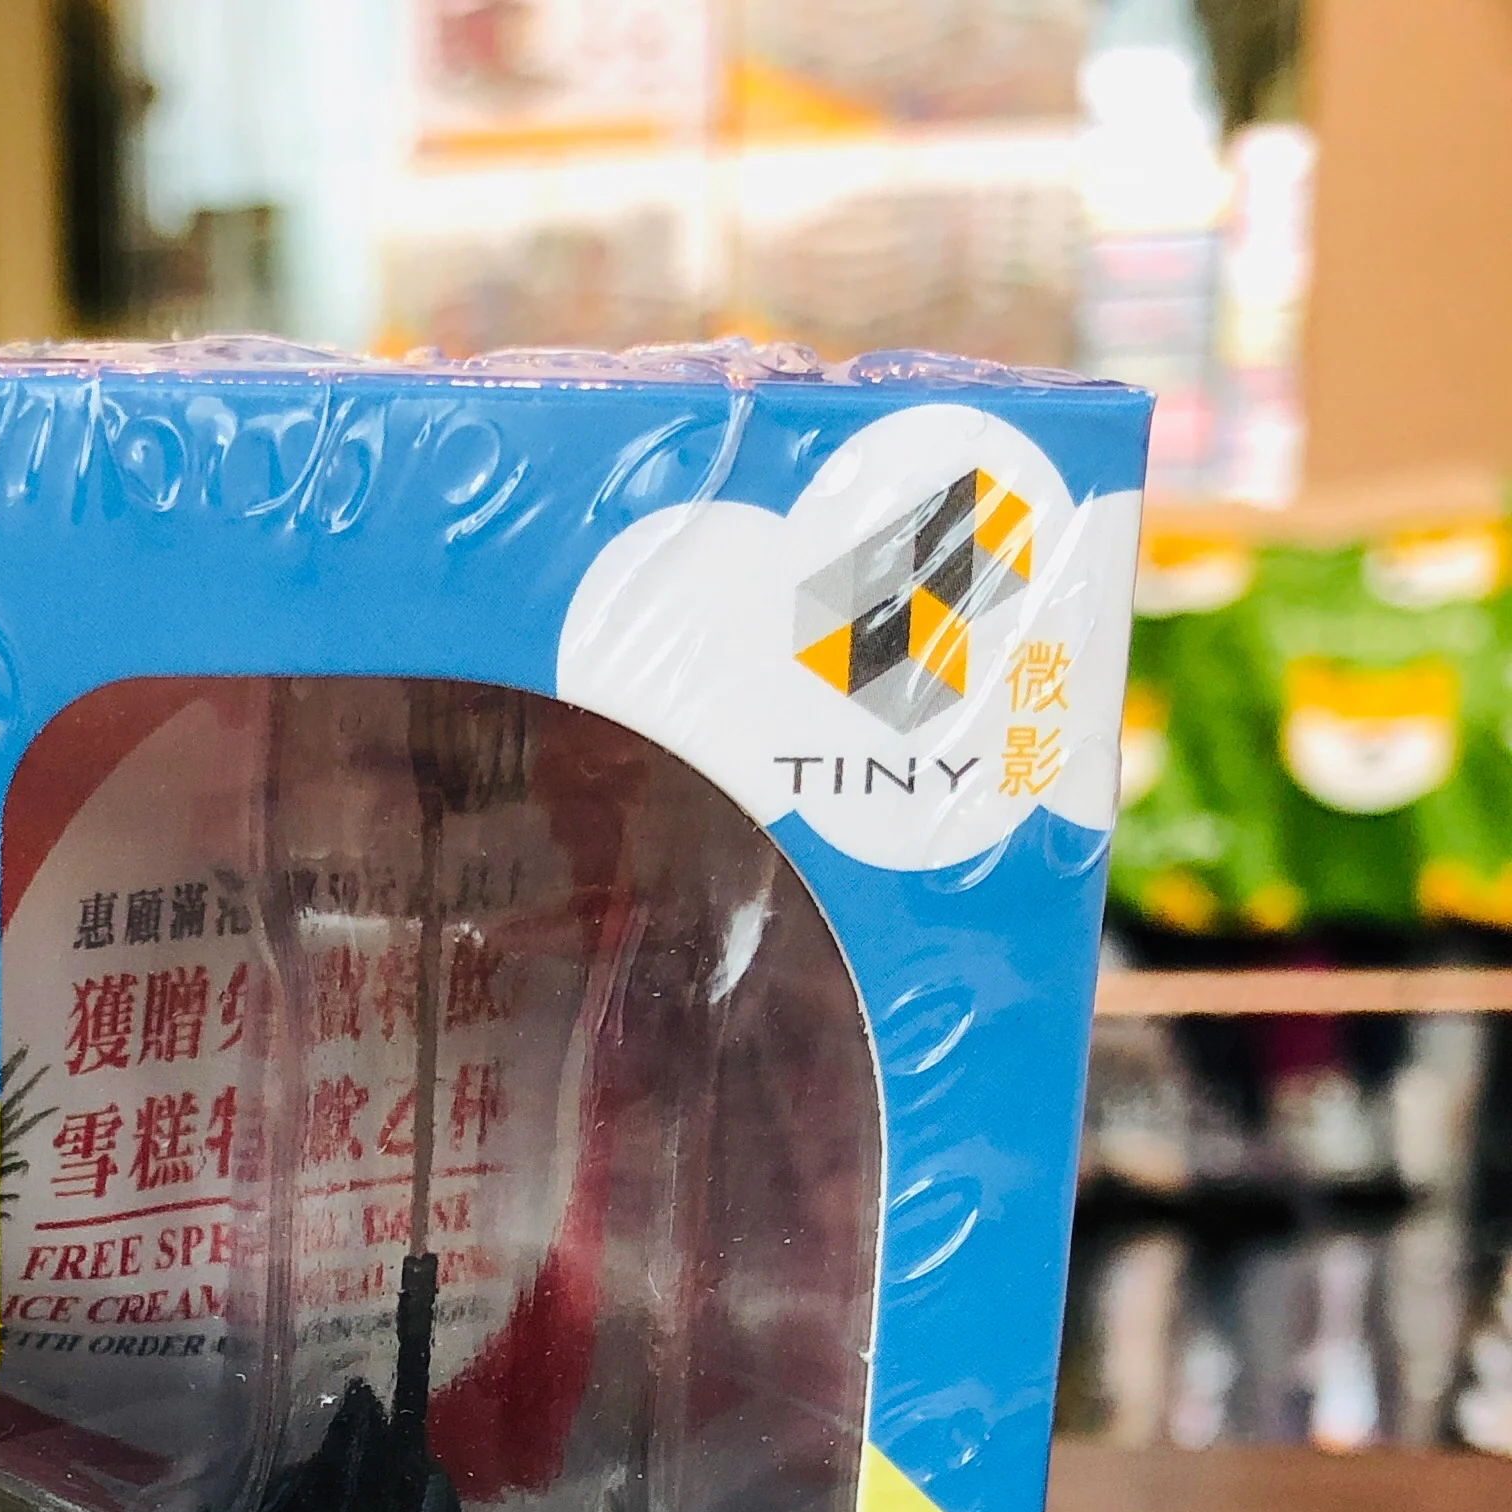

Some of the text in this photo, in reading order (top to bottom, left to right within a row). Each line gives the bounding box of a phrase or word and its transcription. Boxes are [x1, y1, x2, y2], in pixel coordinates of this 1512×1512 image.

[999, 641, 1071, 797] 微影
[773, 756, 982, 795] TINY
[18, 1233, 144, 1282] FREE
[1, 1325, 84, 1353] ITH
